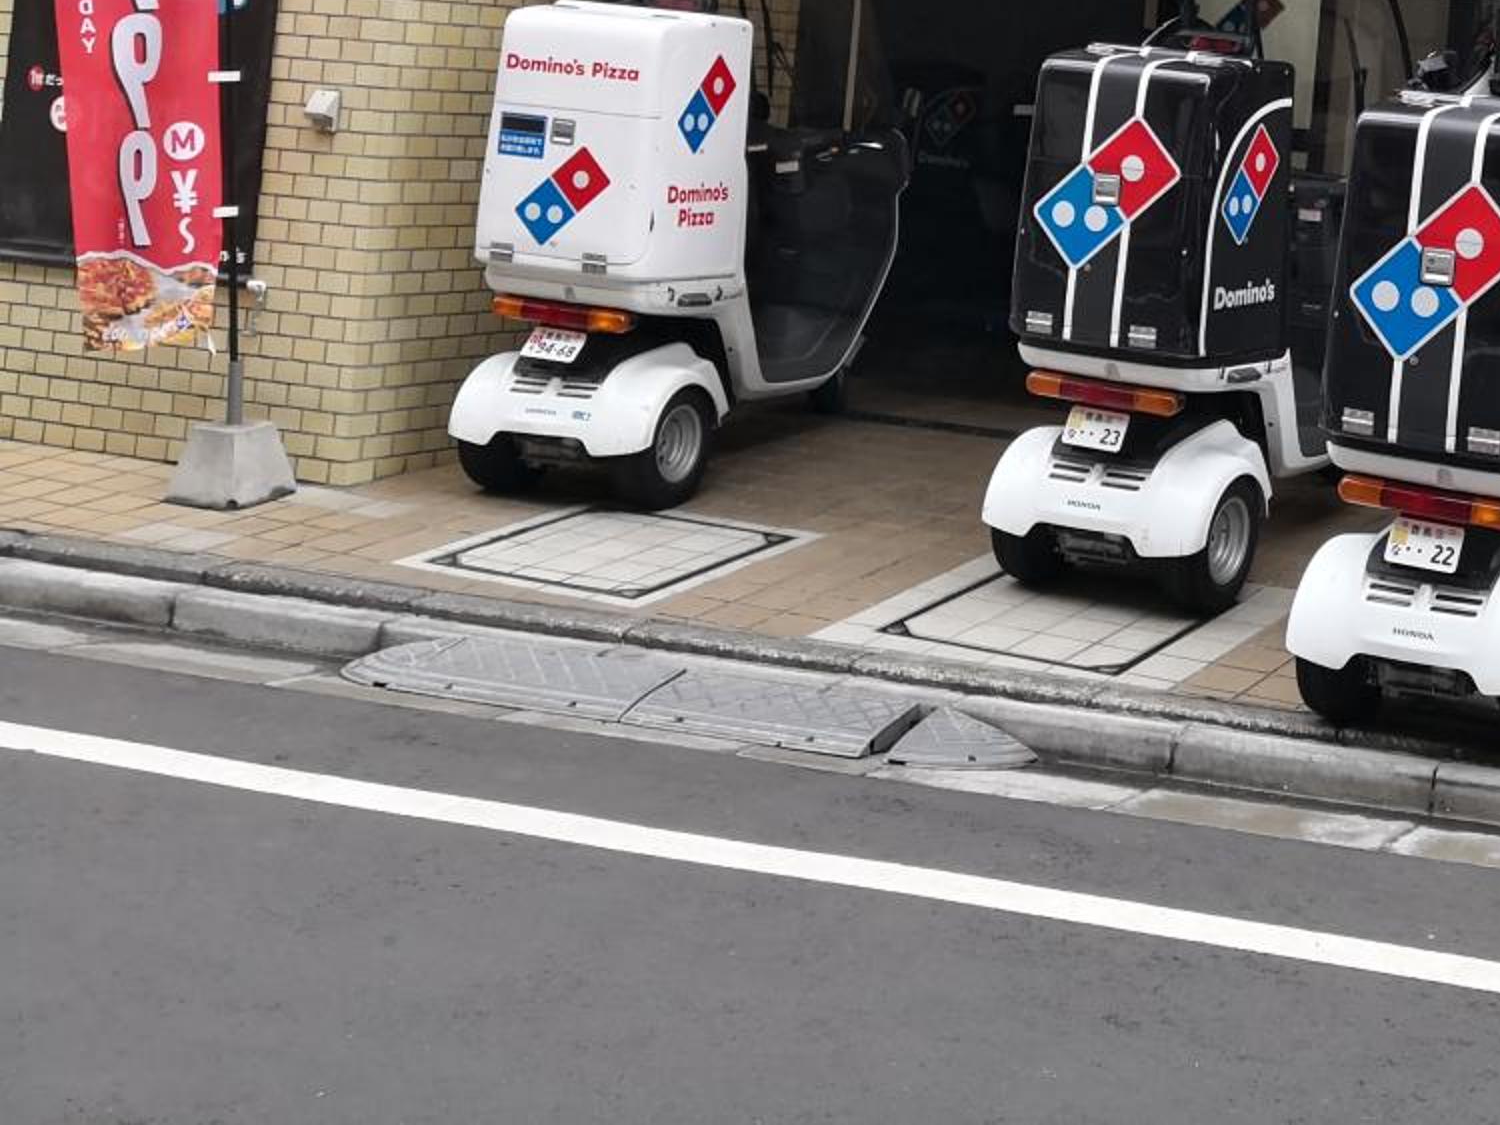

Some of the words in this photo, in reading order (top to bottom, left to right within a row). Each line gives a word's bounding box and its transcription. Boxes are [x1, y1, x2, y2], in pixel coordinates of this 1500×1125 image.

[506, 53, 585, 76] Domino's
[591, 61, 640, 83] Pizza
[667, 181, 729, 205] Domino's
[677, 209, 715, 228] Pizza
[1213, 278, 1276, 311] Domino's
[1392, 626, 1435, 642] HONDA
